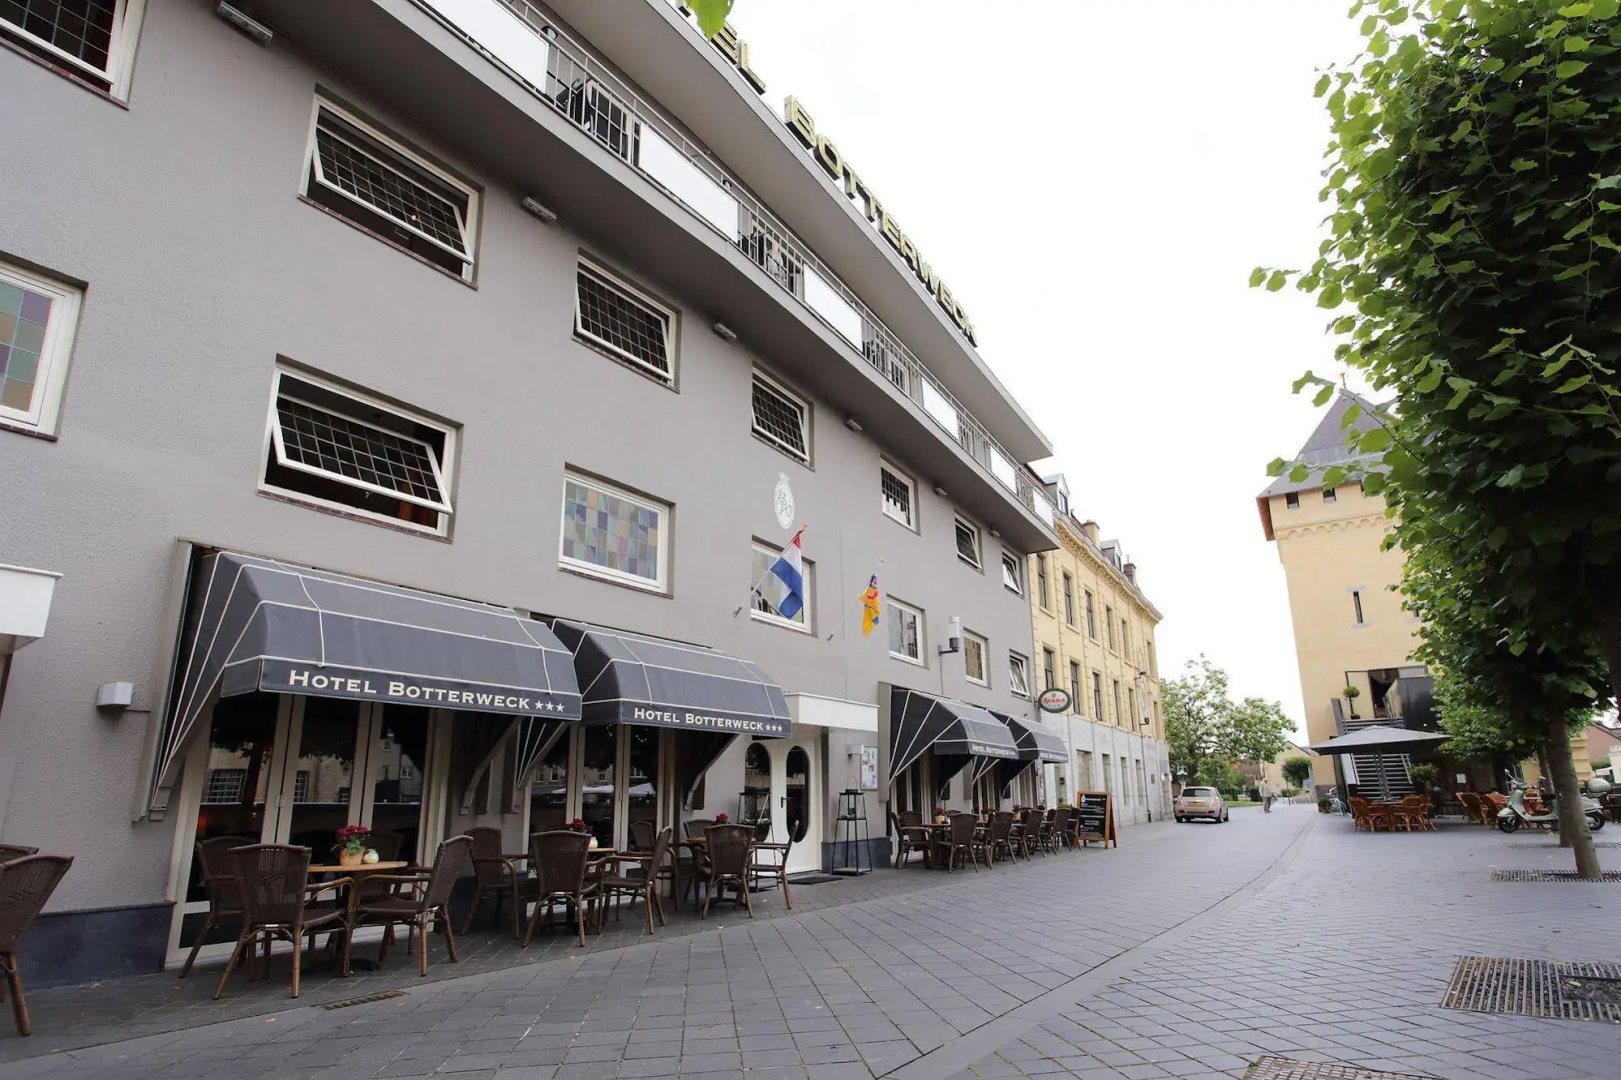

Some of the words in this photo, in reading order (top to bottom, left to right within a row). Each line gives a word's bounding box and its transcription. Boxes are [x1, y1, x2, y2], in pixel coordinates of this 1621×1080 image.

[784, 95, 978, 348] BOTTERWECK
[288, 669, 378, 695] HOTEL
[388, 680, 531, 710] BOTTERWECK
[634, 707, 681, 723] HOTEL
[685, 713, 764, 731] BOTTERWECK
